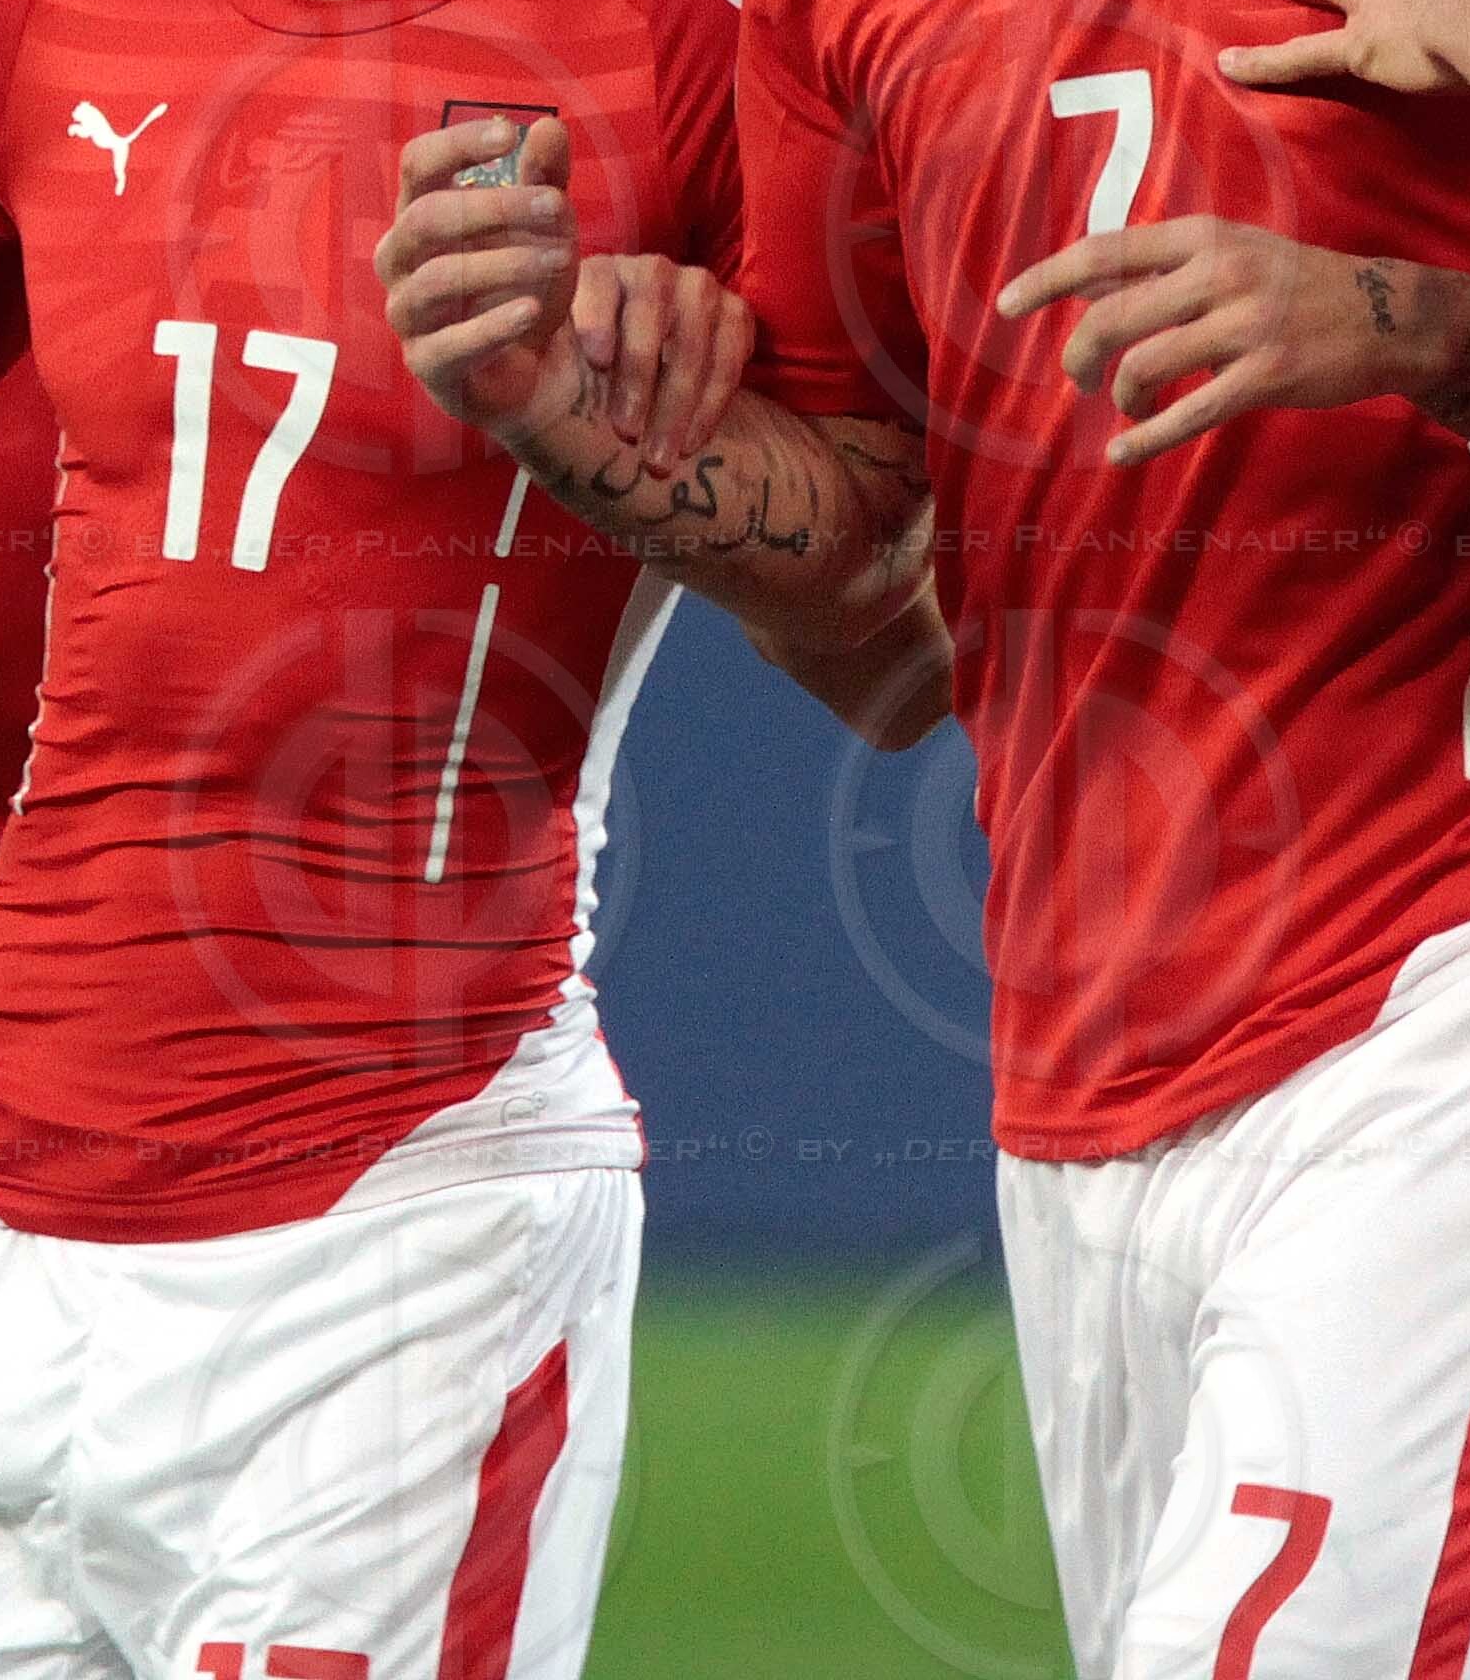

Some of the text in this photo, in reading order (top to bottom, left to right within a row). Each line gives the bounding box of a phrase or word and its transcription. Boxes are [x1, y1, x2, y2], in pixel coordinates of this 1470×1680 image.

[1049, 68, 1154, 237] 7
[153, 319, 339, 572] 17
[1212, 1482, 1333, 1680] 7
